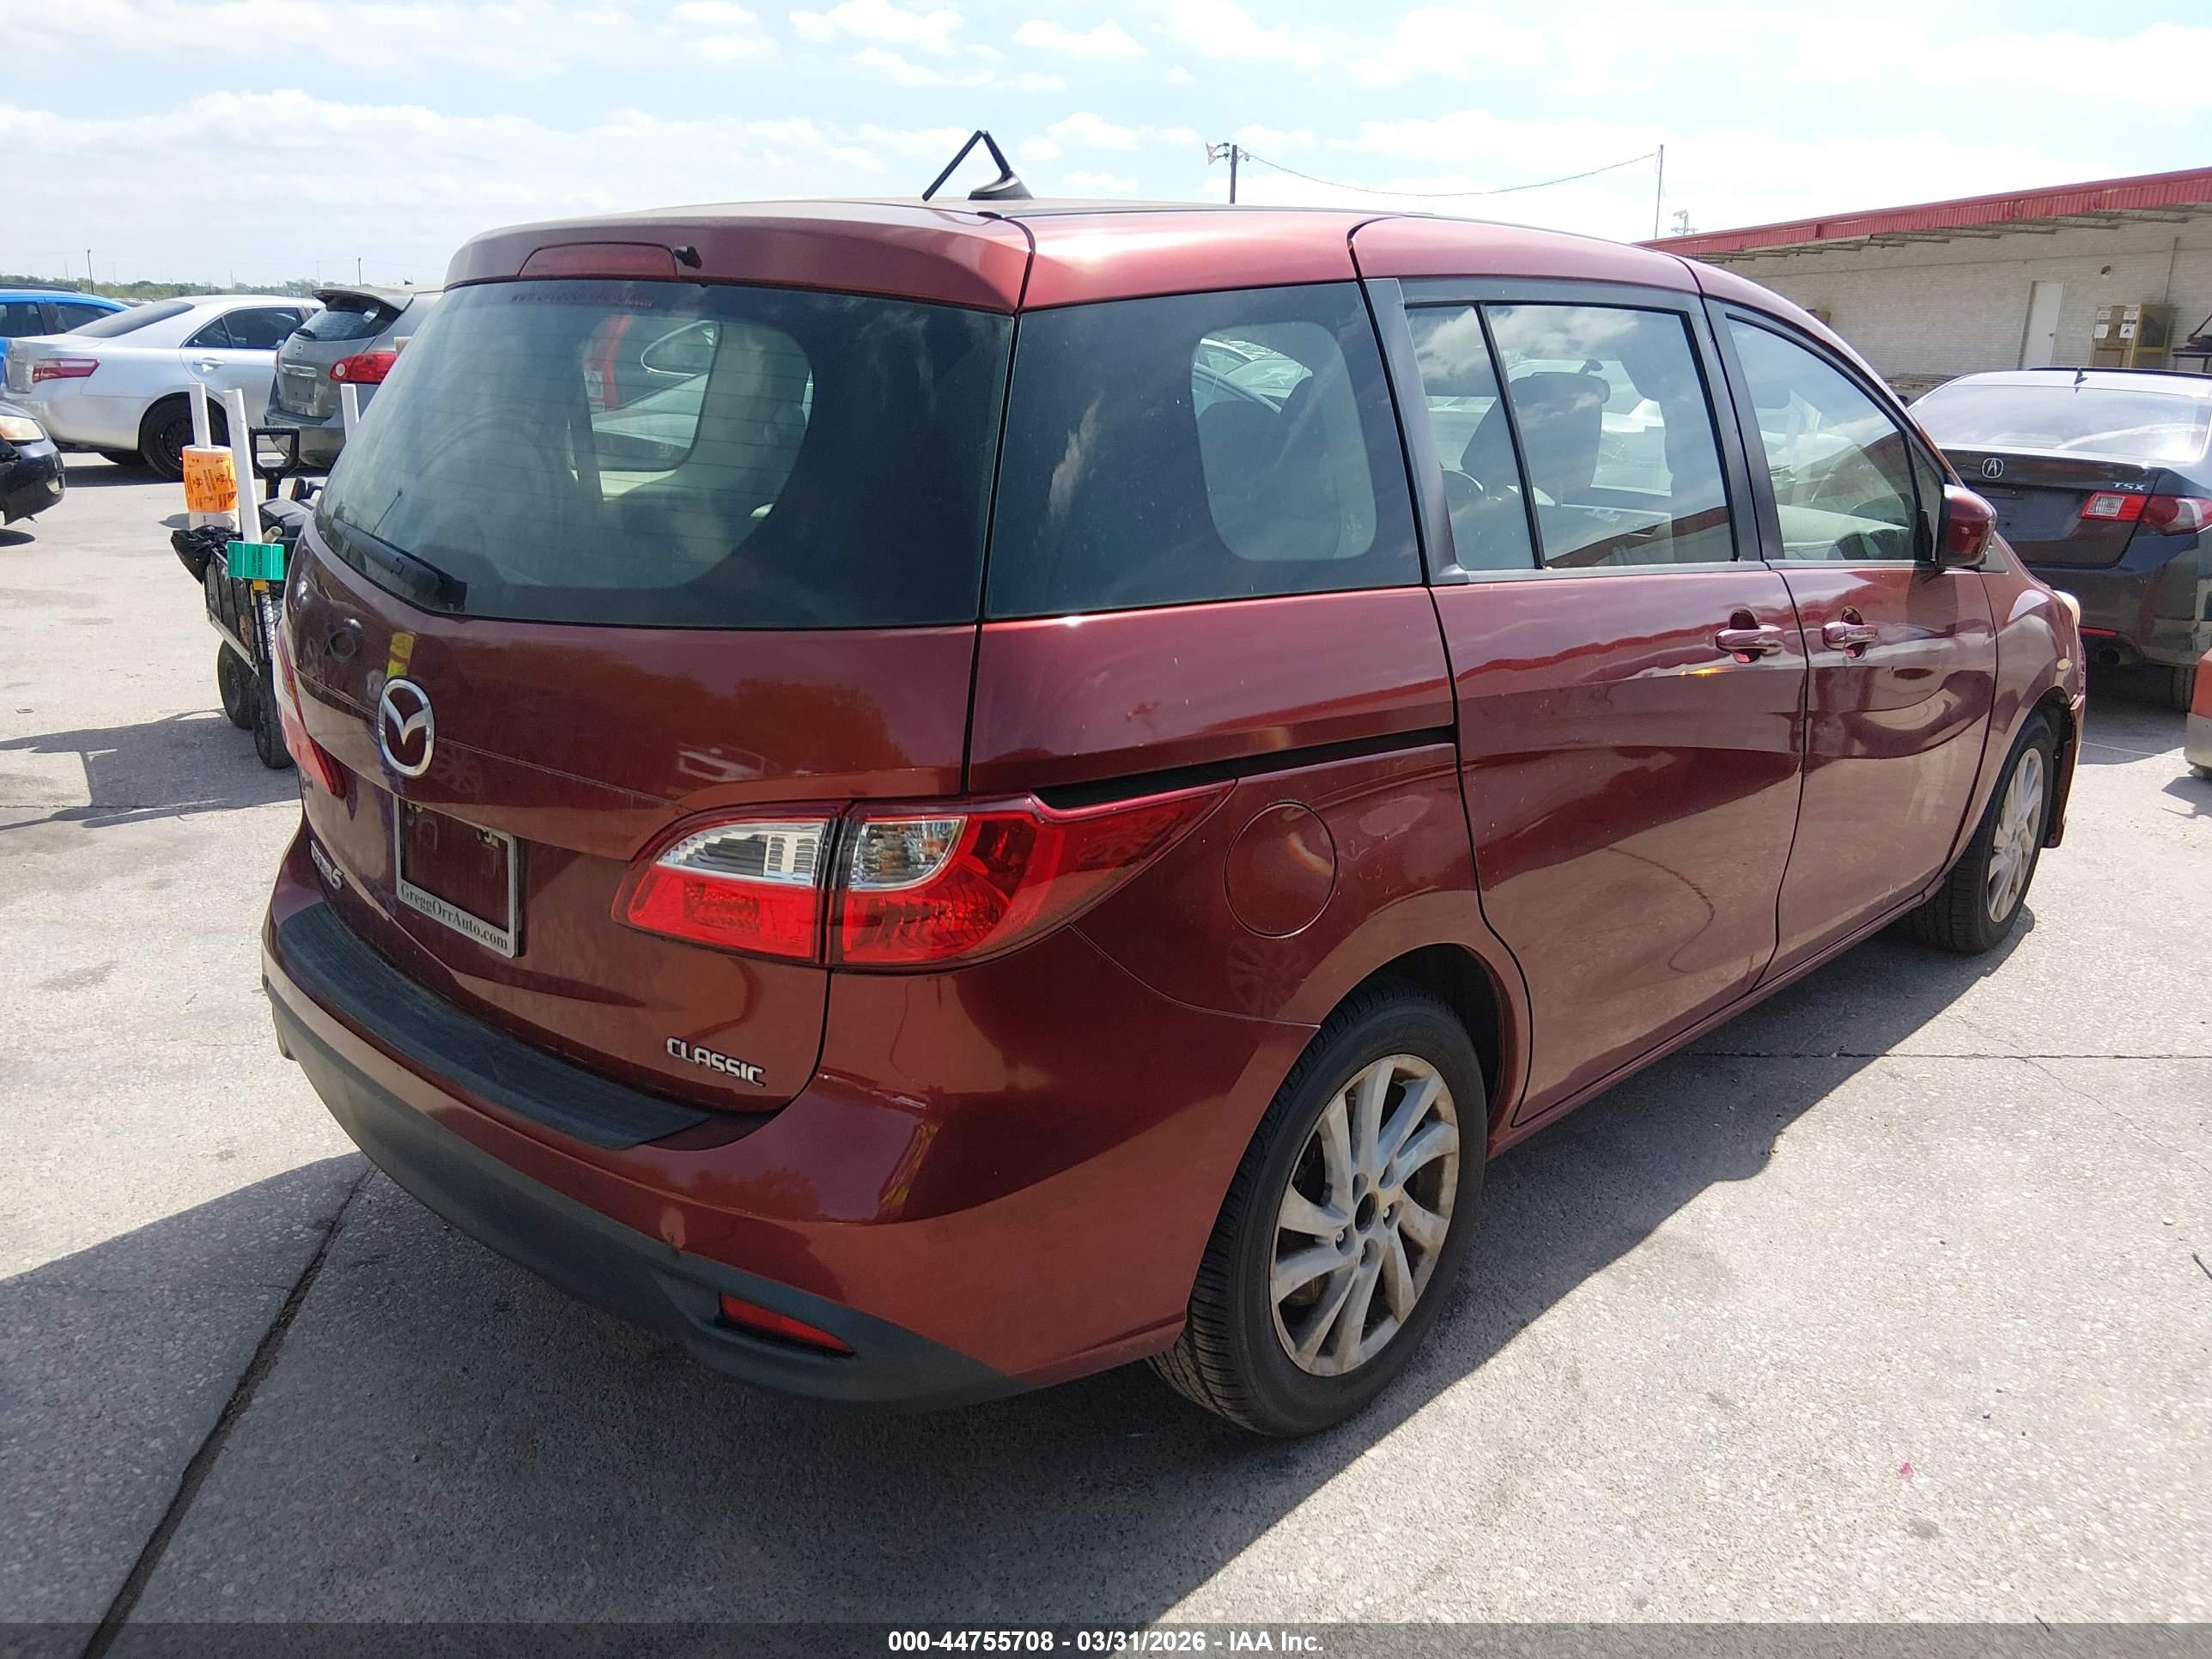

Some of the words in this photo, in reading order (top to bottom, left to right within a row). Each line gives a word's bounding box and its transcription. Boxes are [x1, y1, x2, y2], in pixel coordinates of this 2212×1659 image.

[2112, 482, 2146, 491] TSX
[400, 884, 508, 950] GreggOrrAuto.com
[665, 1036, 765, 1087] CLASSIC
